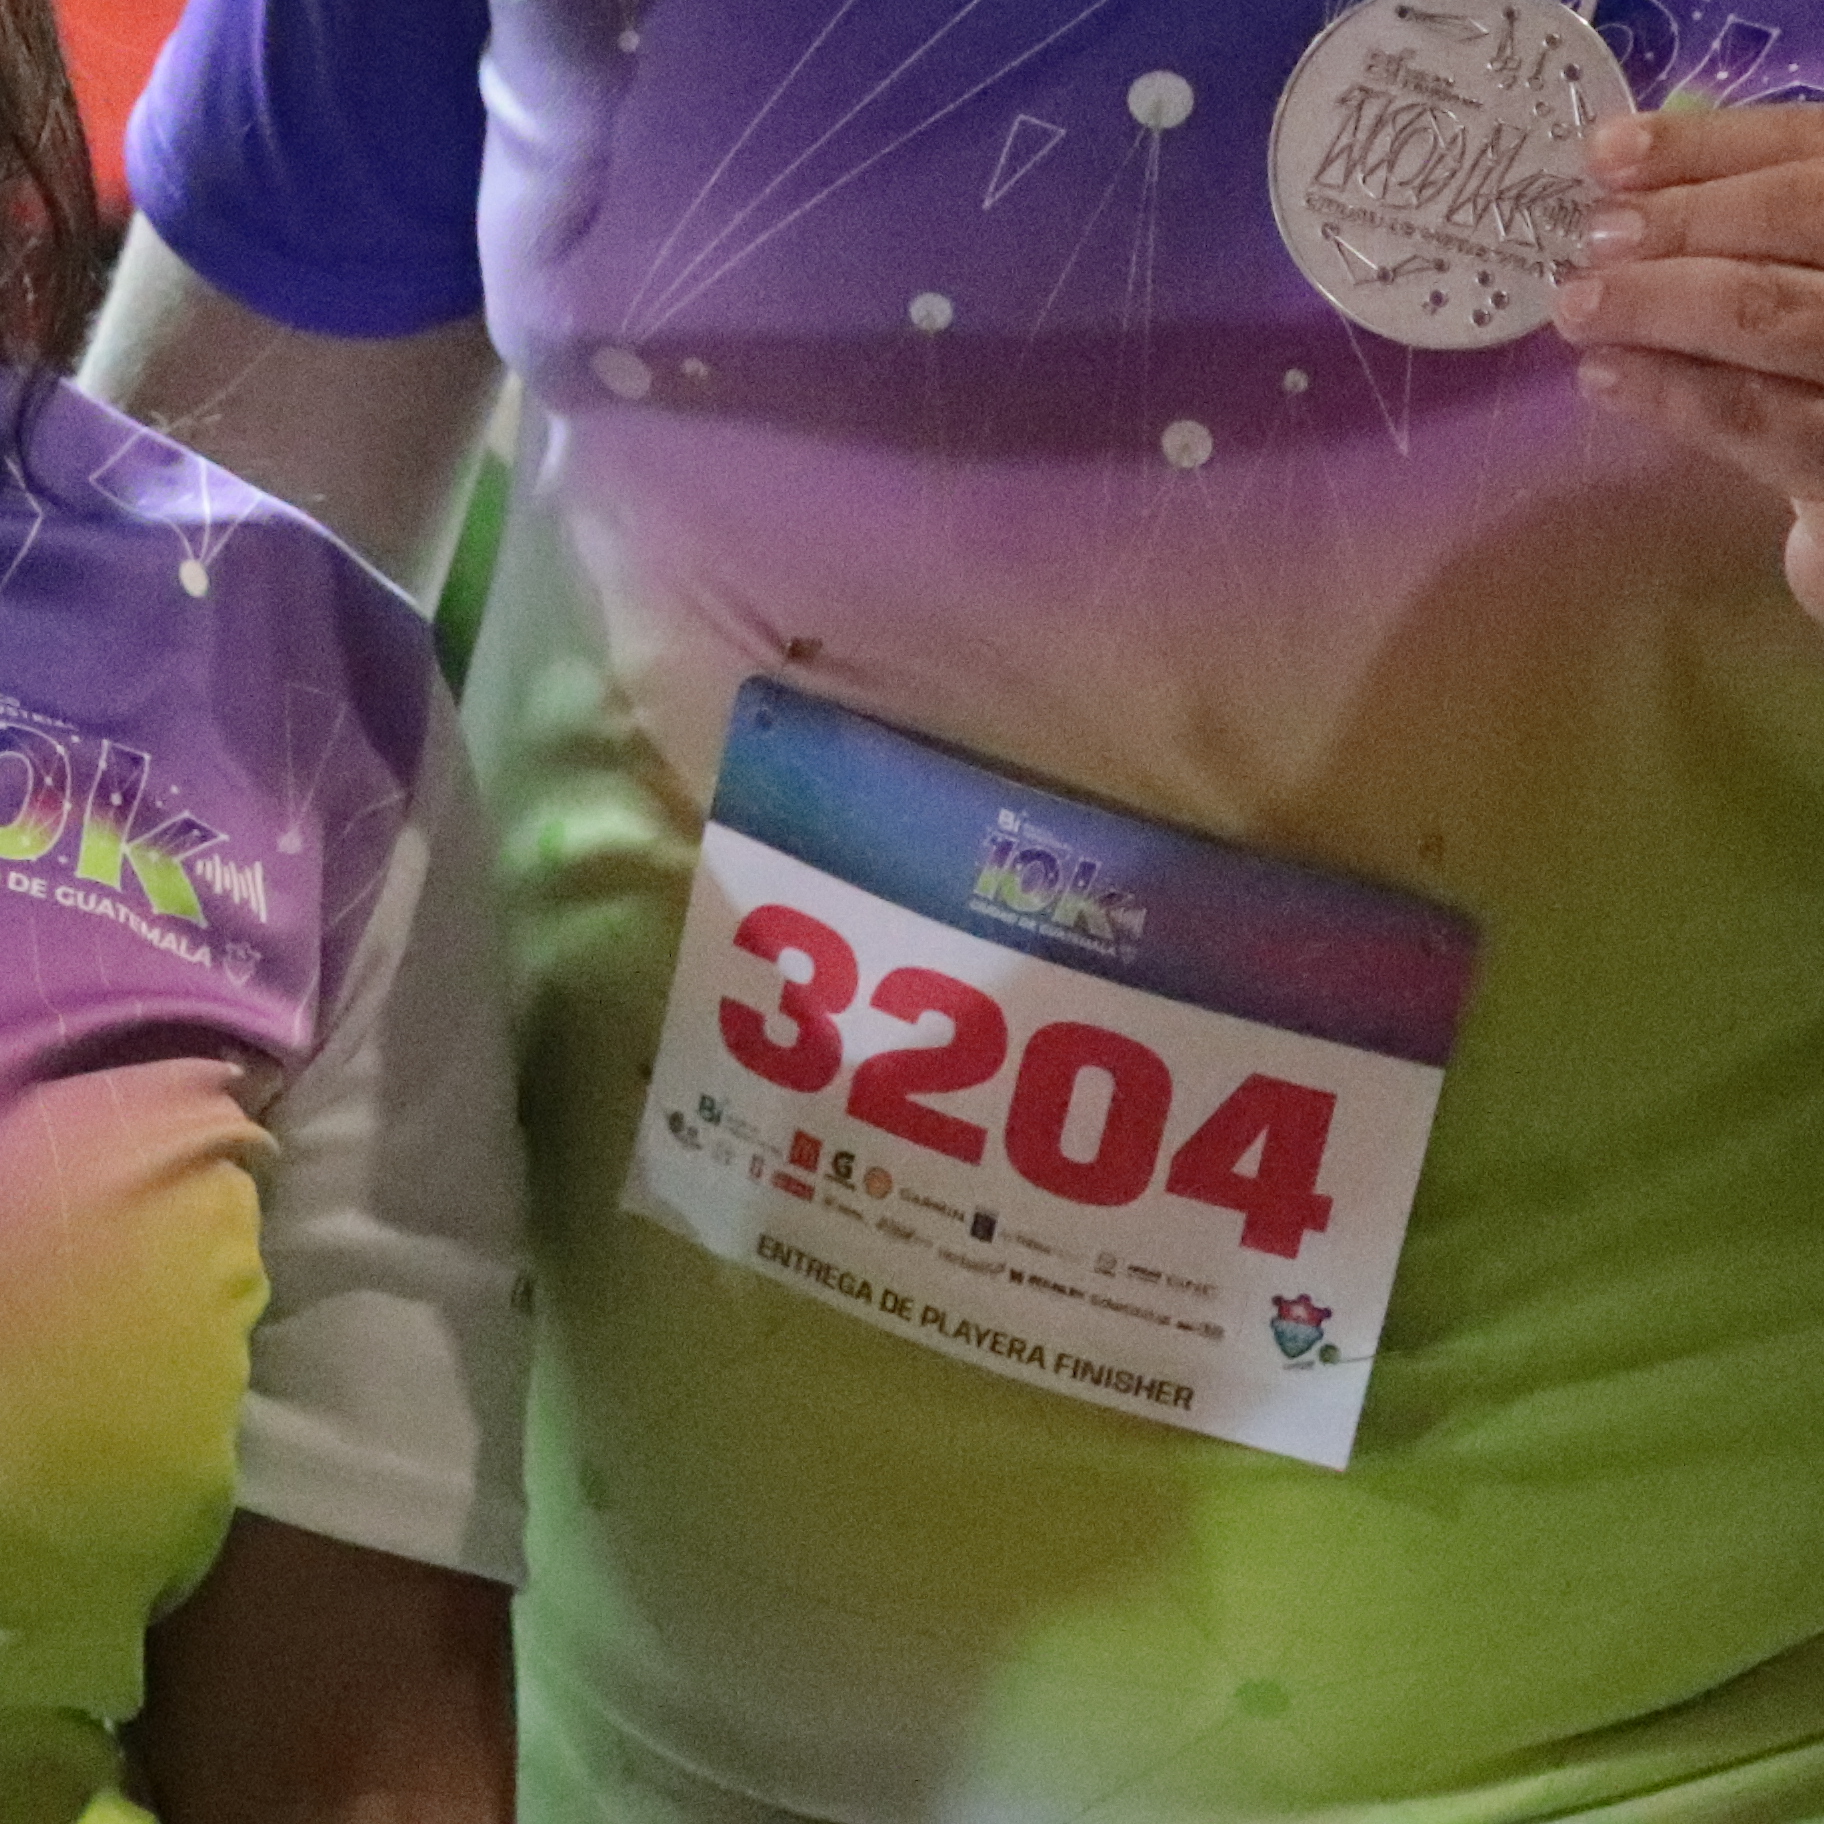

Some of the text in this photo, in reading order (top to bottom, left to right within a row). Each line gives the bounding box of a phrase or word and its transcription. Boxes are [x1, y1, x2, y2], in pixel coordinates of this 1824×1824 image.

[7, 870, 48, 900] DE
[54, 883, 214, 968] GUATEMALA
[717, 903, 1338, 1261] 3204
[755, 1231, 874, 1305] ENTREGA
[878, 1288, 913, 1323] DE
[919, 1304, 1048, 1371] PLAYERA
[1053, 1351, 1197, 1412] FINISHER
